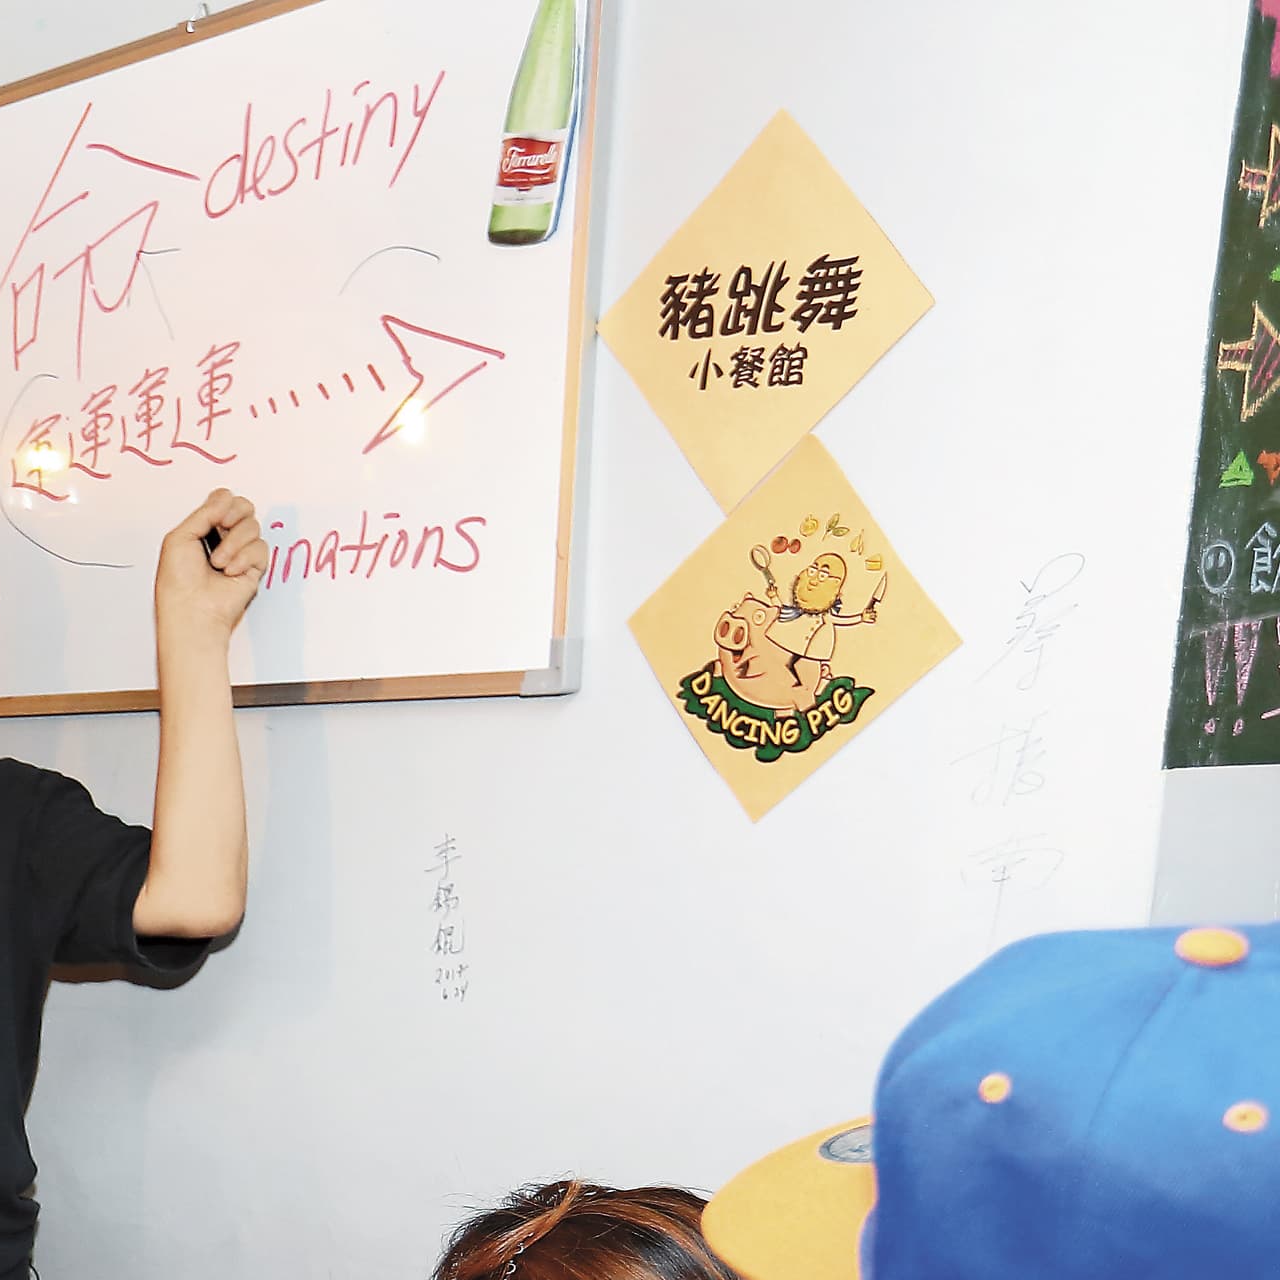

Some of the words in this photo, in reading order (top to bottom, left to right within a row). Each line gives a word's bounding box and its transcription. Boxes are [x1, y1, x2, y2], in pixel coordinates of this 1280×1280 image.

[203, 70, 446, 219] destiny
[657, 253, 865, 342] 豬跳舞
[687, 342, 809, 391] 小餐館
[690, 670, 801, 747] DANCING
[805, 686, 855, 736] PIG
